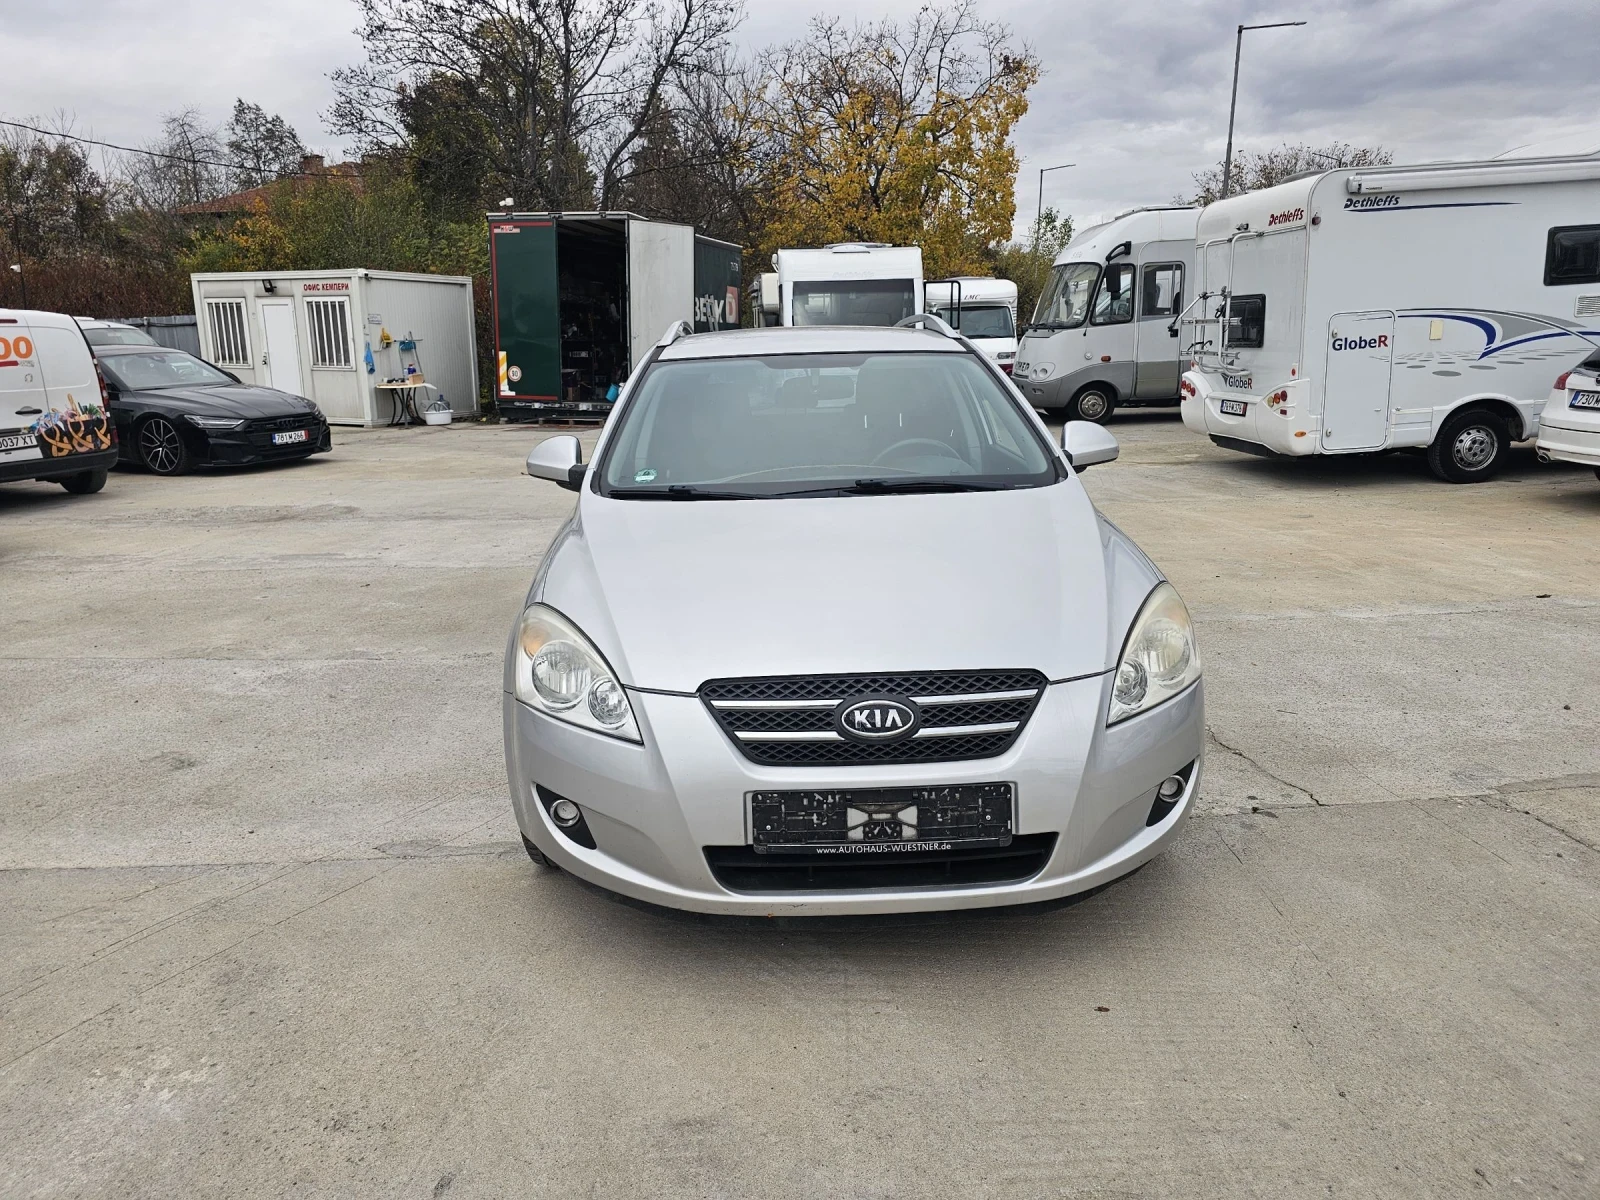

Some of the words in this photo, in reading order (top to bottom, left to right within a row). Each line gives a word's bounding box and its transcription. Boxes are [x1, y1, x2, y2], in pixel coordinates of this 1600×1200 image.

[1344, 195, 1401, 209] Dethleffs
[1268, 207, 1304, 226] Dethleffs
[303, 283, 321, 291] ОФИС
[321, 282, 350, 291] КЕМПЕРИ
[1331, 334, 1389, 351] GlobeR
[1228, 375, 1253, 390] GlobeR
[854, 709, 903, 728] KIA
[816, 843, 952, 854] www.AUTOHAUS-WUESTNER.de
